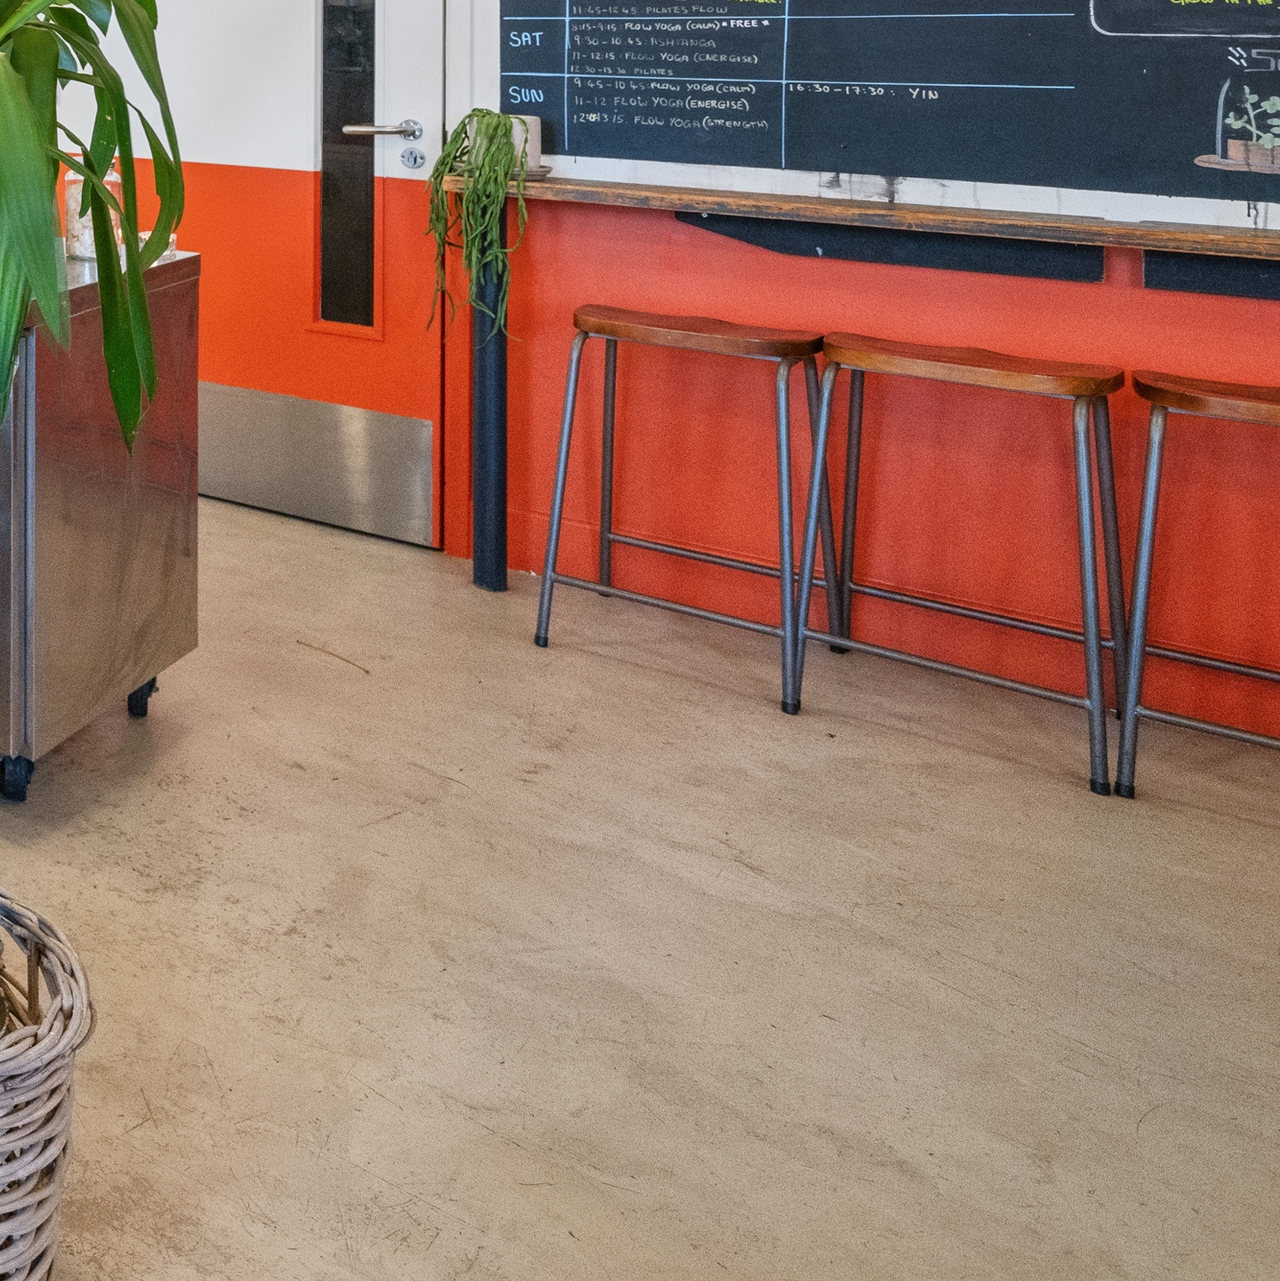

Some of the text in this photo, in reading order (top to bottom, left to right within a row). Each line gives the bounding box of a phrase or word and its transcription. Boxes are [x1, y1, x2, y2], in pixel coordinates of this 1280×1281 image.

[509, 31, 544, 47] SAT
[509, 86, 544, 104] SUN
[909, 88, 939, 100] YIN
